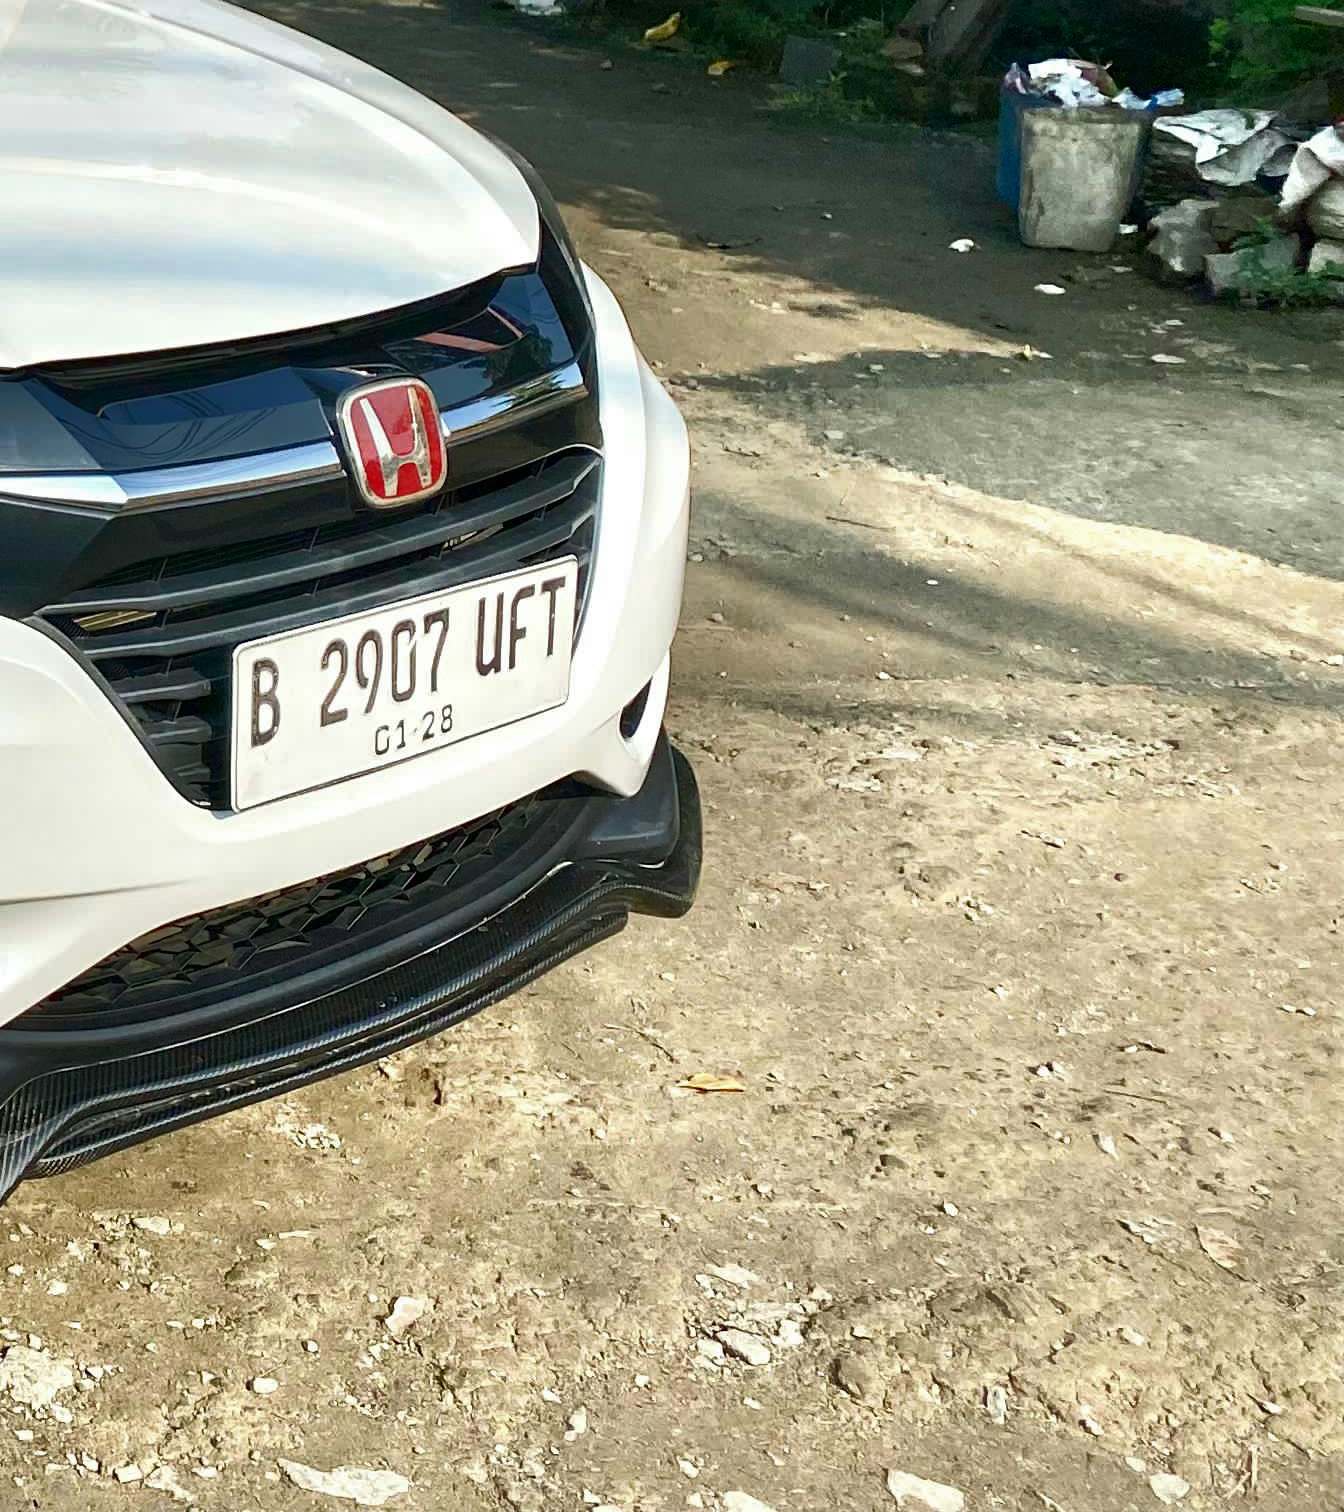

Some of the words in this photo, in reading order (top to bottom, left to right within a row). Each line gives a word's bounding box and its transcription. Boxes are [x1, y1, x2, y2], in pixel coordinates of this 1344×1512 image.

[251, 656, 281, 748] B
[319, 607, 450, 728] 2907
[475, 576, 566, 676] UFT
